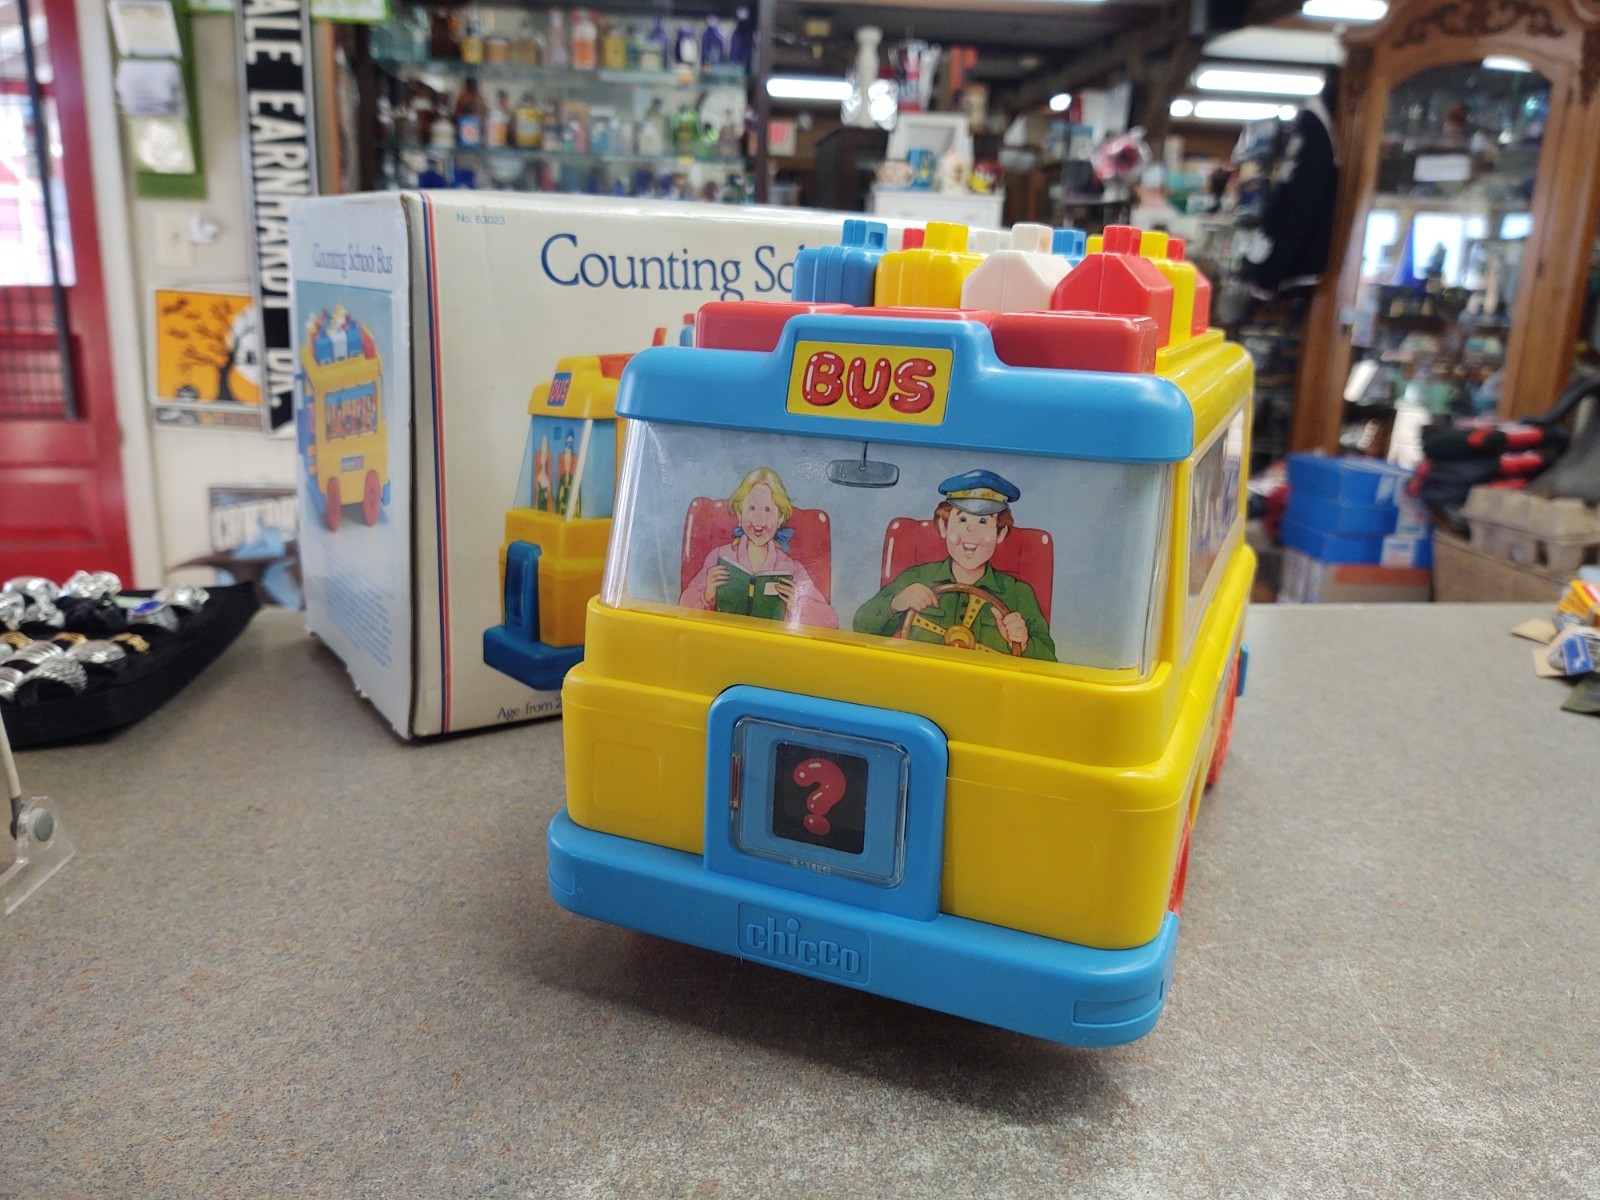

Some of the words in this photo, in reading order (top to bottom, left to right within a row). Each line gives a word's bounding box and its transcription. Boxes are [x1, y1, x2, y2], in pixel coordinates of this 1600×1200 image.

[456, 213, 473, 224] No.
[541, 233, 744, 301] Counting
[755, 244, 805, 293] Sc
[549, 378, 570, 403] BUS
[802, 351, 937, 414] BUS
[497, 706, 519, 720] Age
[525, 701, 553, 715] from
[746, 916, 860, 975] chicco
